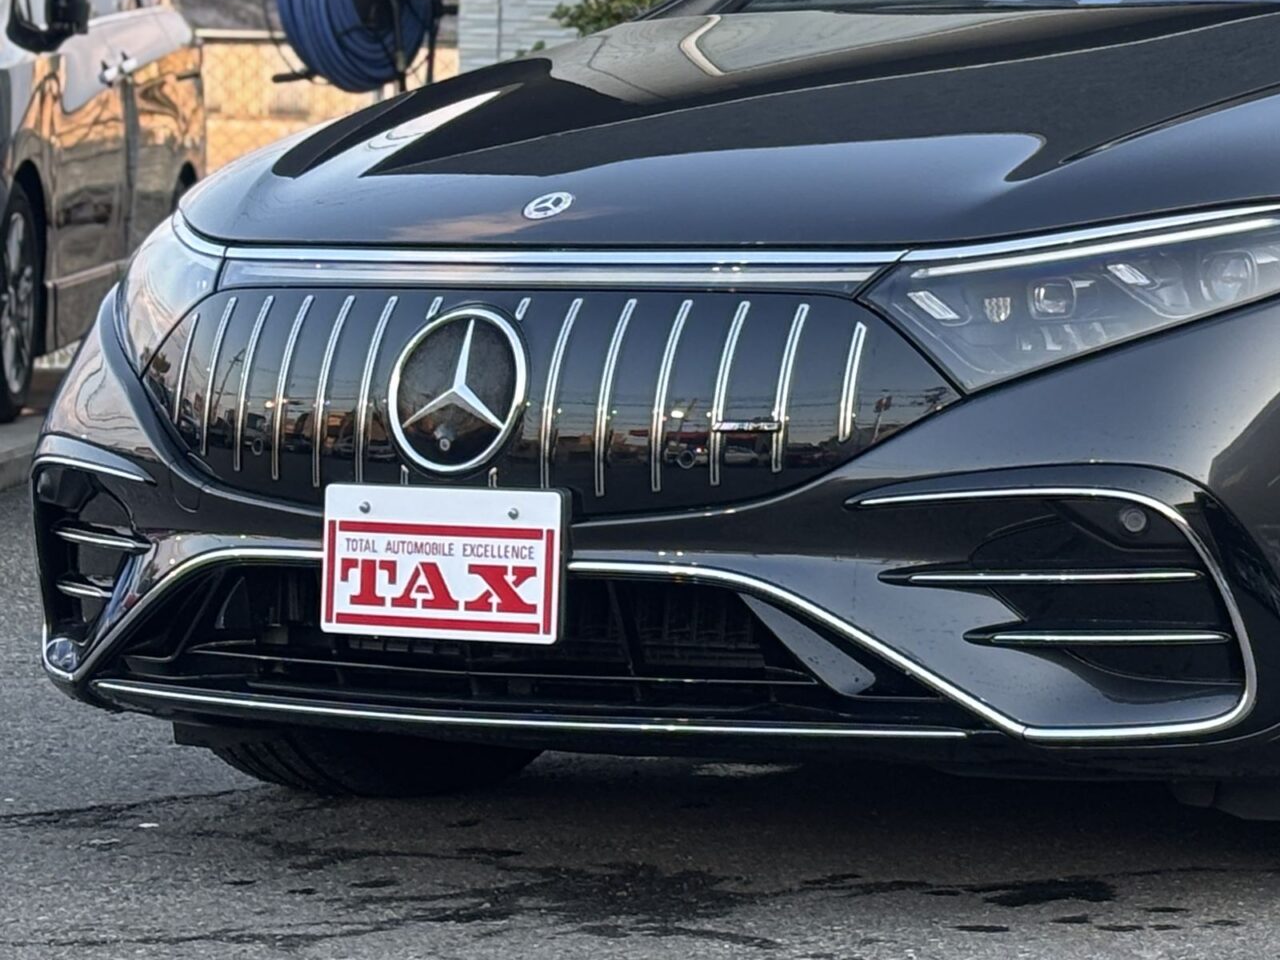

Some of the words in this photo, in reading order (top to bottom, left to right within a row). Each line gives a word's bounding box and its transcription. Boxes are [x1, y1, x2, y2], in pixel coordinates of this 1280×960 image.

[345, 538, 378, 553] TOTAL
[385, 540, 455, 556] AUTOMOBILE
[462, 543, 535, 560] EXCELLENCE
[341, 558, 537, 614] TAX
